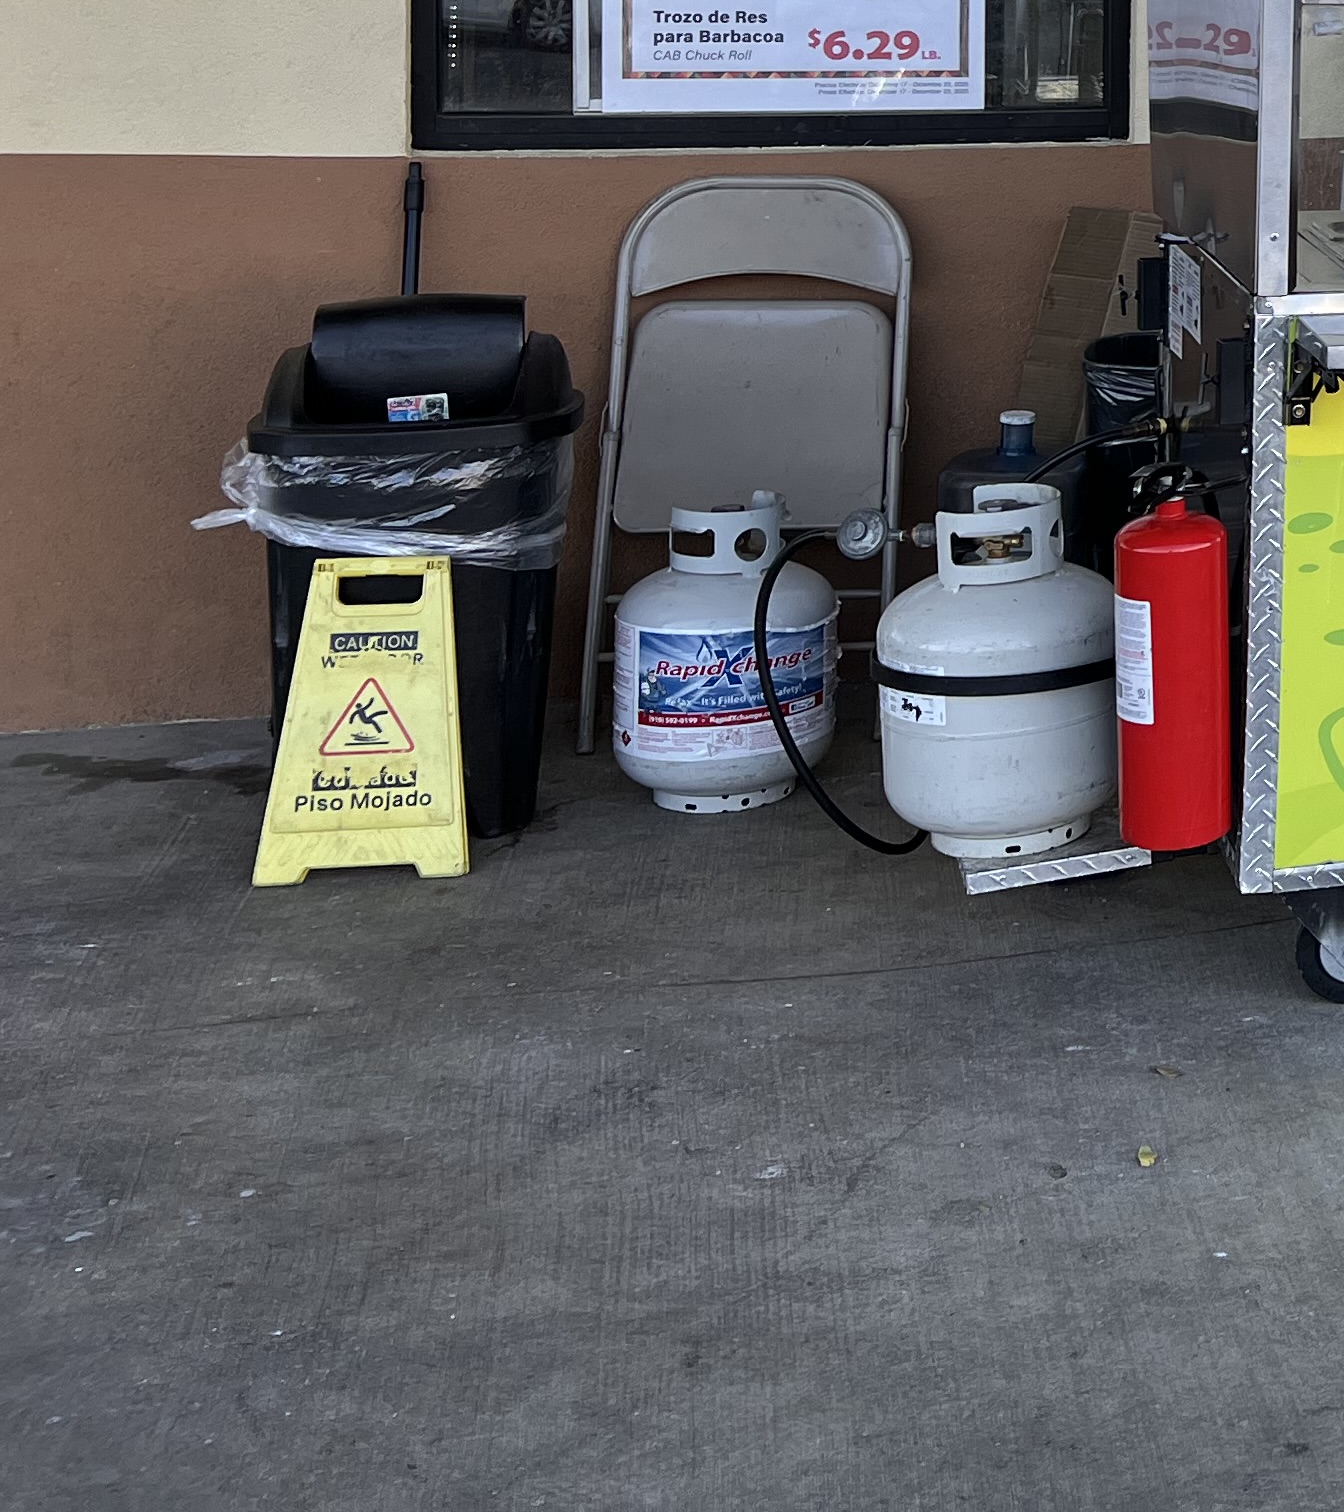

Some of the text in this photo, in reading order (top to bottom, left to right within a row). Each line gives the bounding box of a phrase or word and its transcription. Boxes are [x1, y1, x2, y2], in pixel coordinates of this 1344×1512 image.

[653, 10, 768, 24] Trozo de Res
[653, 30, 784, 46] para Barbacoa
[808, 28, 941, 61] $6.29 LB.
[653, 50, 752, 61] CAB Chuck Roll
[333, 634, 416, 651] CAUTION
[655, 645, 812, 689] RapidXchnge
[701, 696, 717, 706] It's
[719, 694, 746, 706] Filled
[749, 691, 765, 701] wit
[294, 790, 432, 813] Piso Mojado
